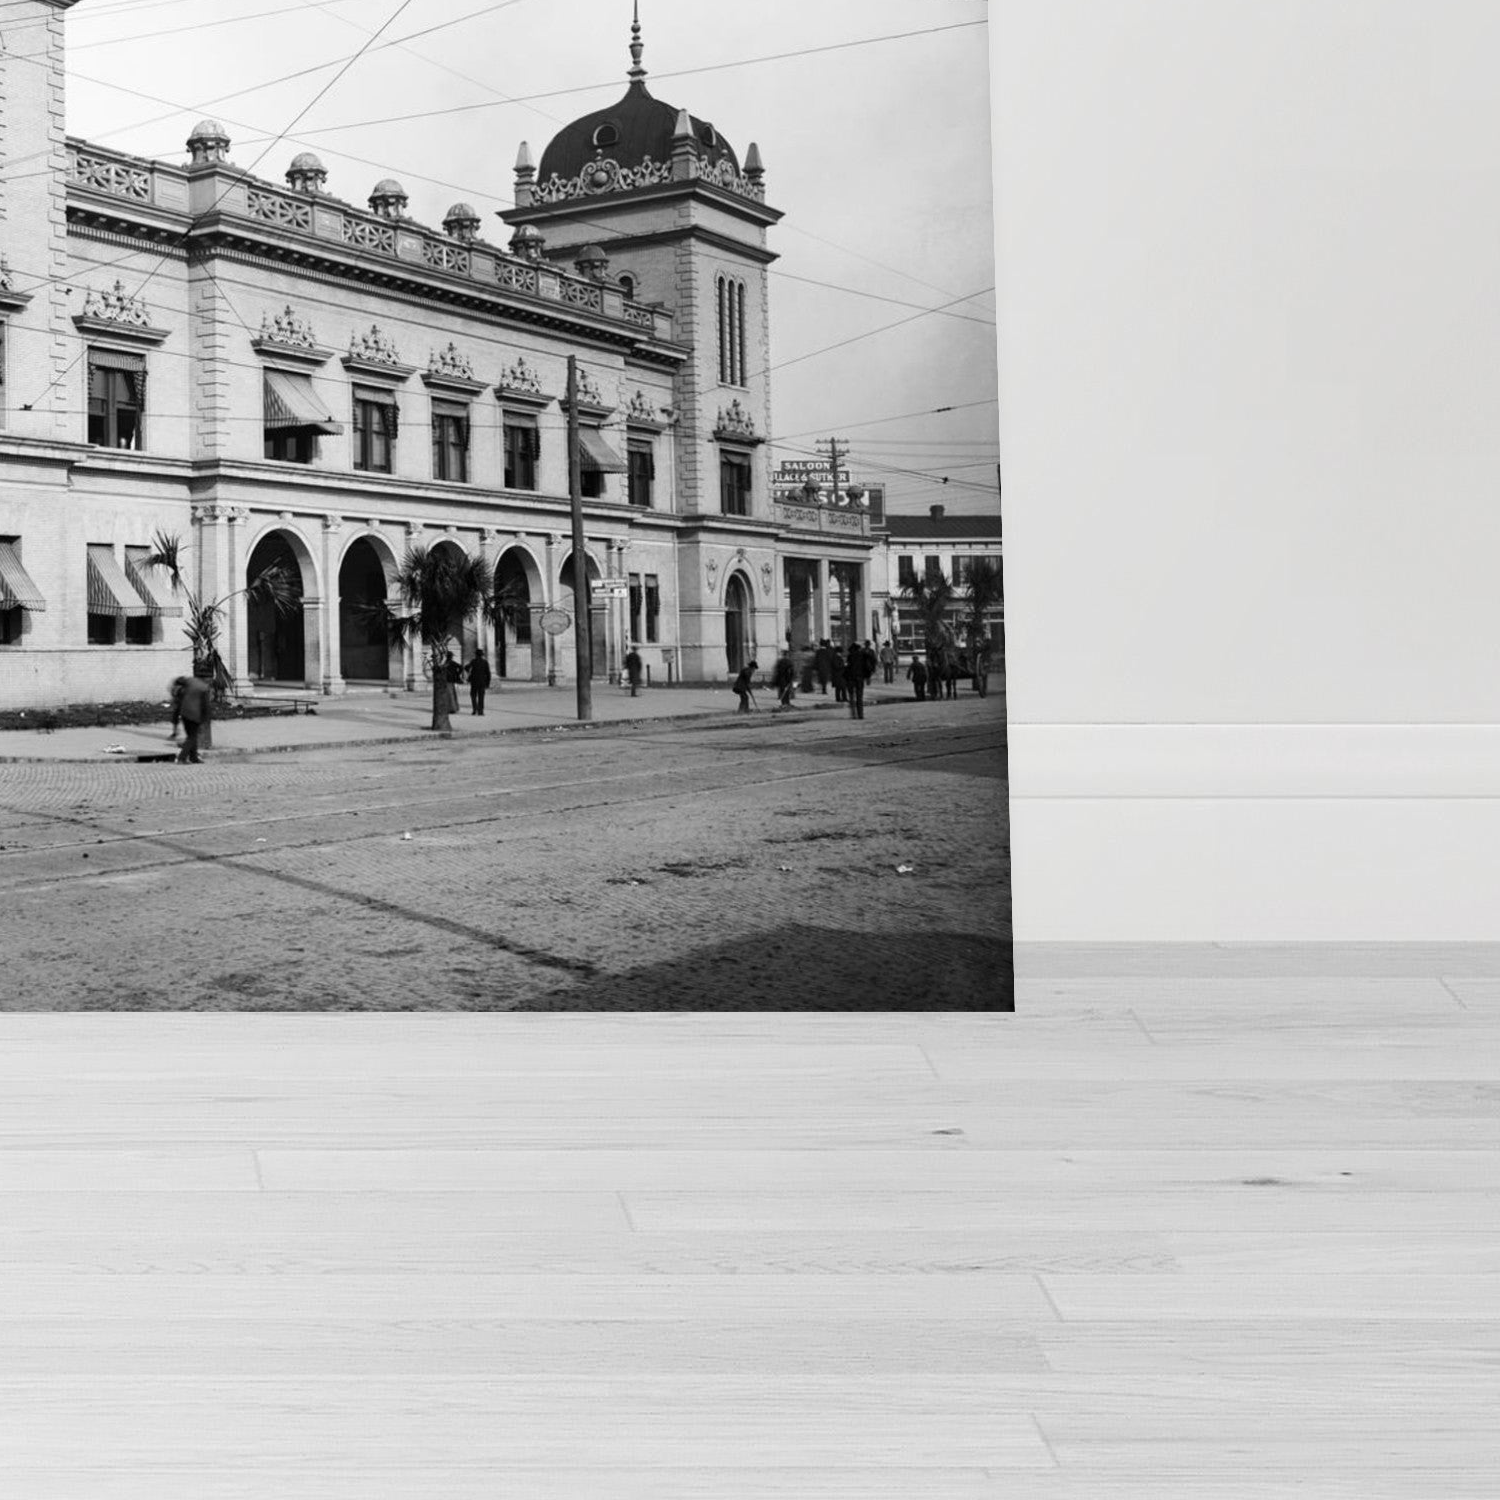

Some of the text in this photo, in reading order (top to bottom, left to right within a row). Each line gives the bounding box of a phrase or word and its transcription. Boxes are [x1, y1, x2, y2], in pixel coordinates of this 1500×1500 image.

[784, 462, 831, 470] SALOON
[800, 473, 808, 482] &
[809, 473, 847, 481] SUTKR
